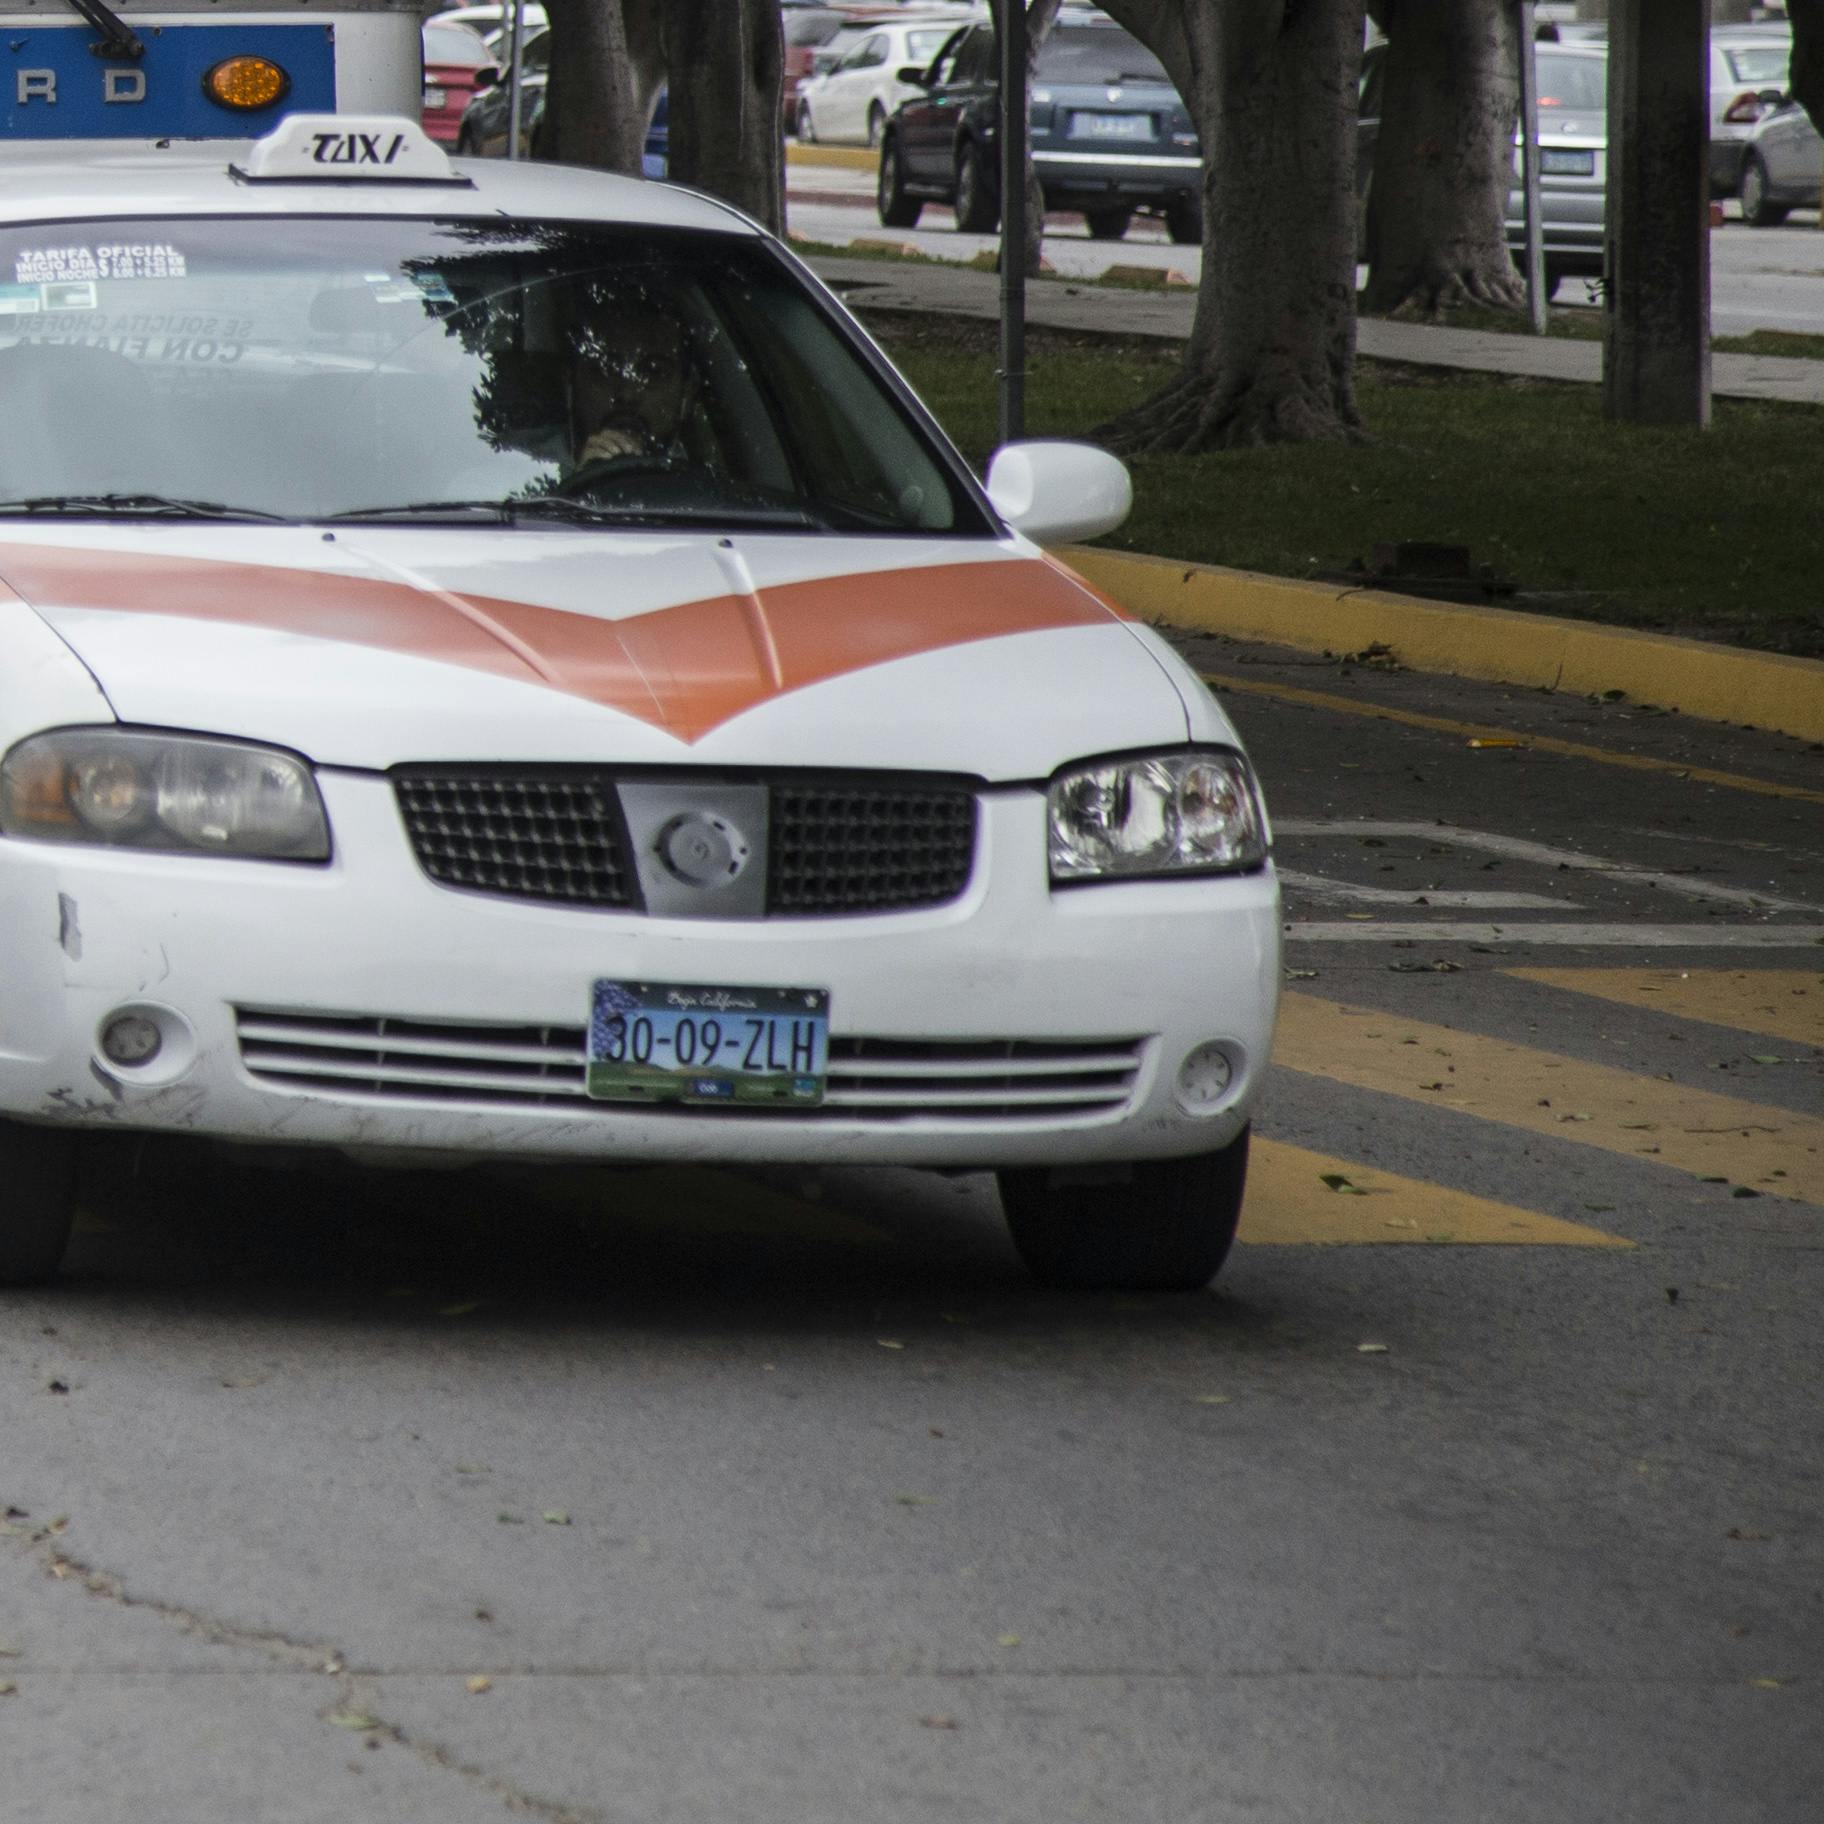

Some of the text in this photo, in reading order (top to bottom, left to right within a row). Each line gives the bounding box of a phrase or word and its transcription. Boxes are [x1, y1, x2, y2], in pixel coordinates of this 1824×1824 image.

[312, 133, 405, 165] TAXI
[20, 243, 179, 263] TARIFA OFICIAL
[605, 1016, 815, 1072] 30-09-ZLH
